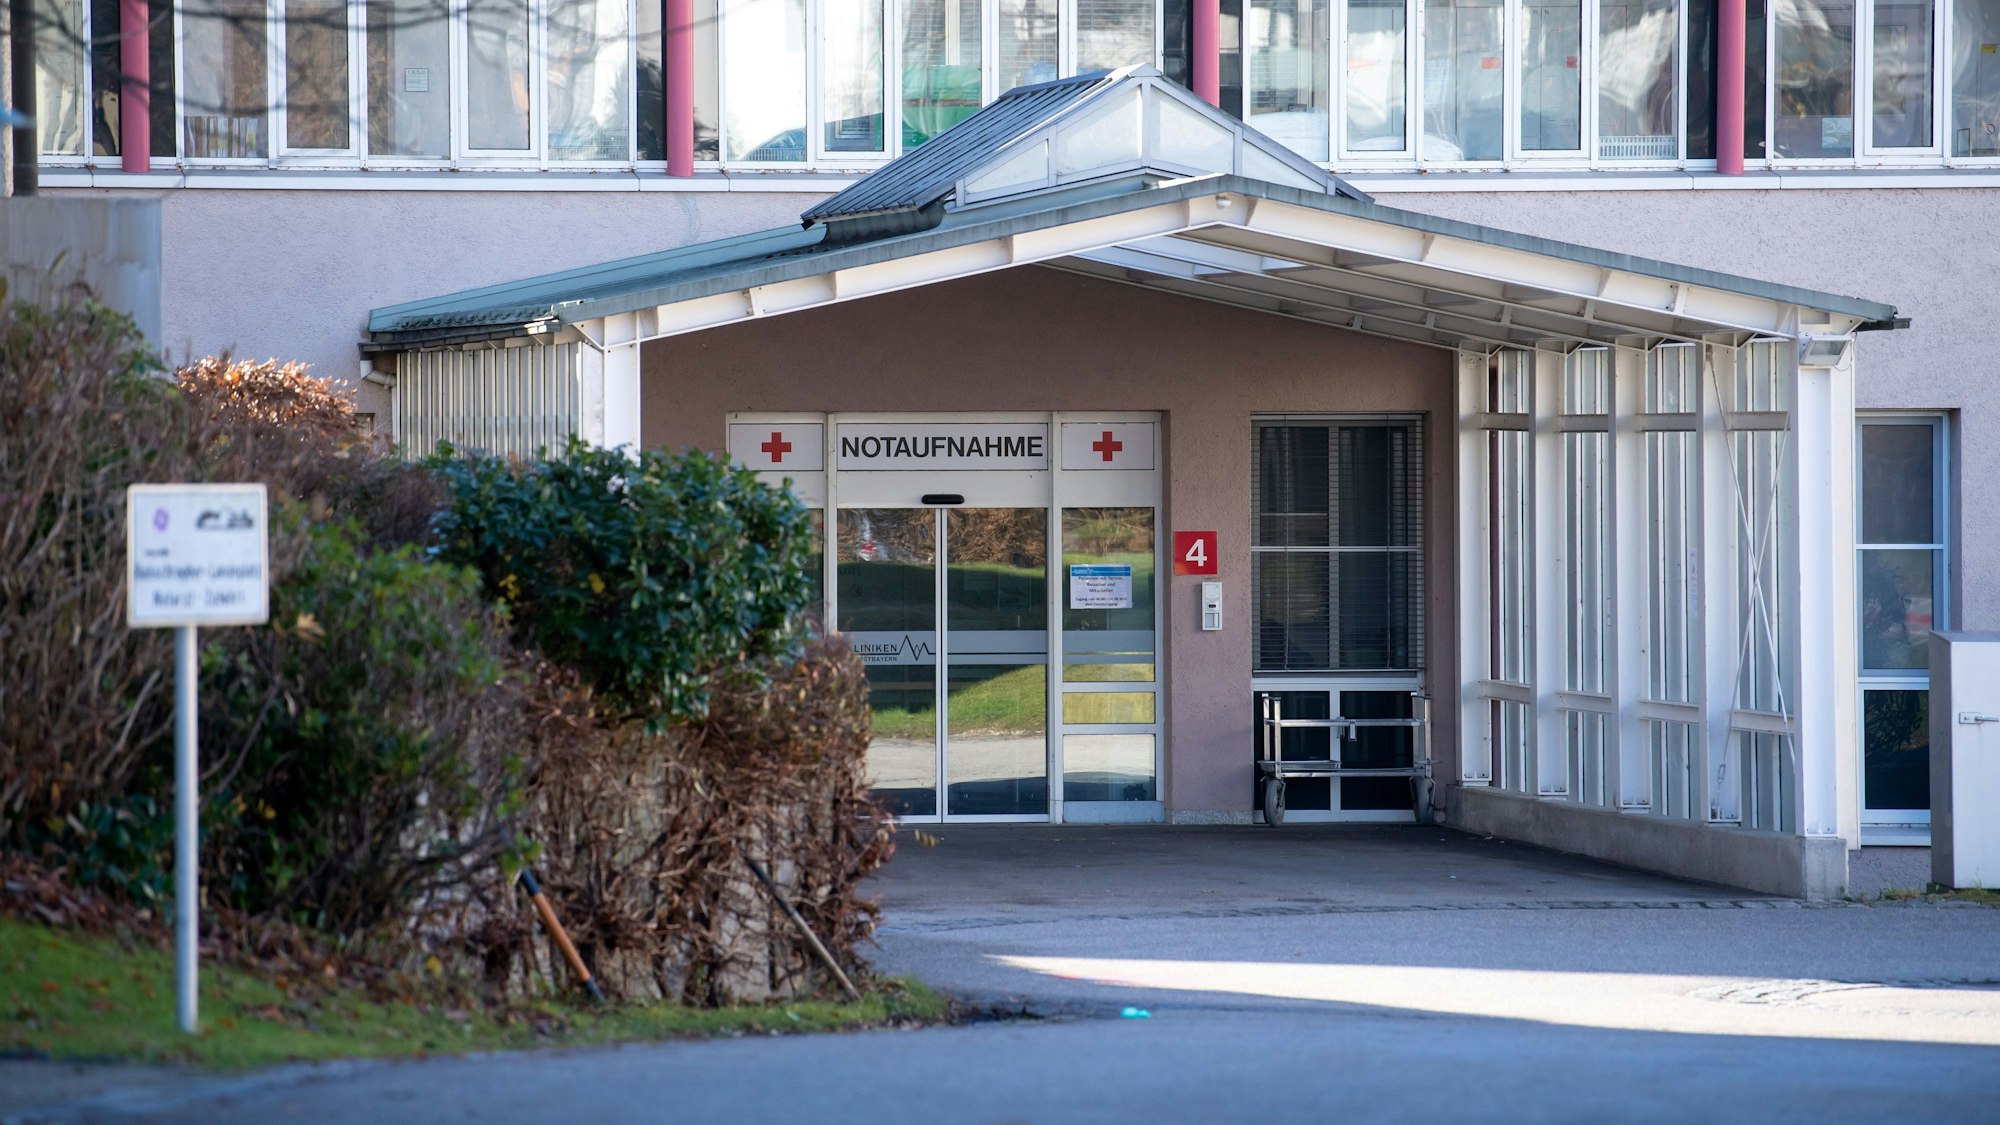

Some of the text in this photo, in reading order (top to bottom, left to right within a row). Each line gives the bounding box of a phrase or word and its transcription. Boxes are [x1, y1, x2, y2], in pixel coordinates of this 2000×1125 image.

[841, 436, 1043, 458] NOTAUFNAHME
[1185, 538, 1208, 567] 4
[850, 644, 897, 653] LINIKEN
